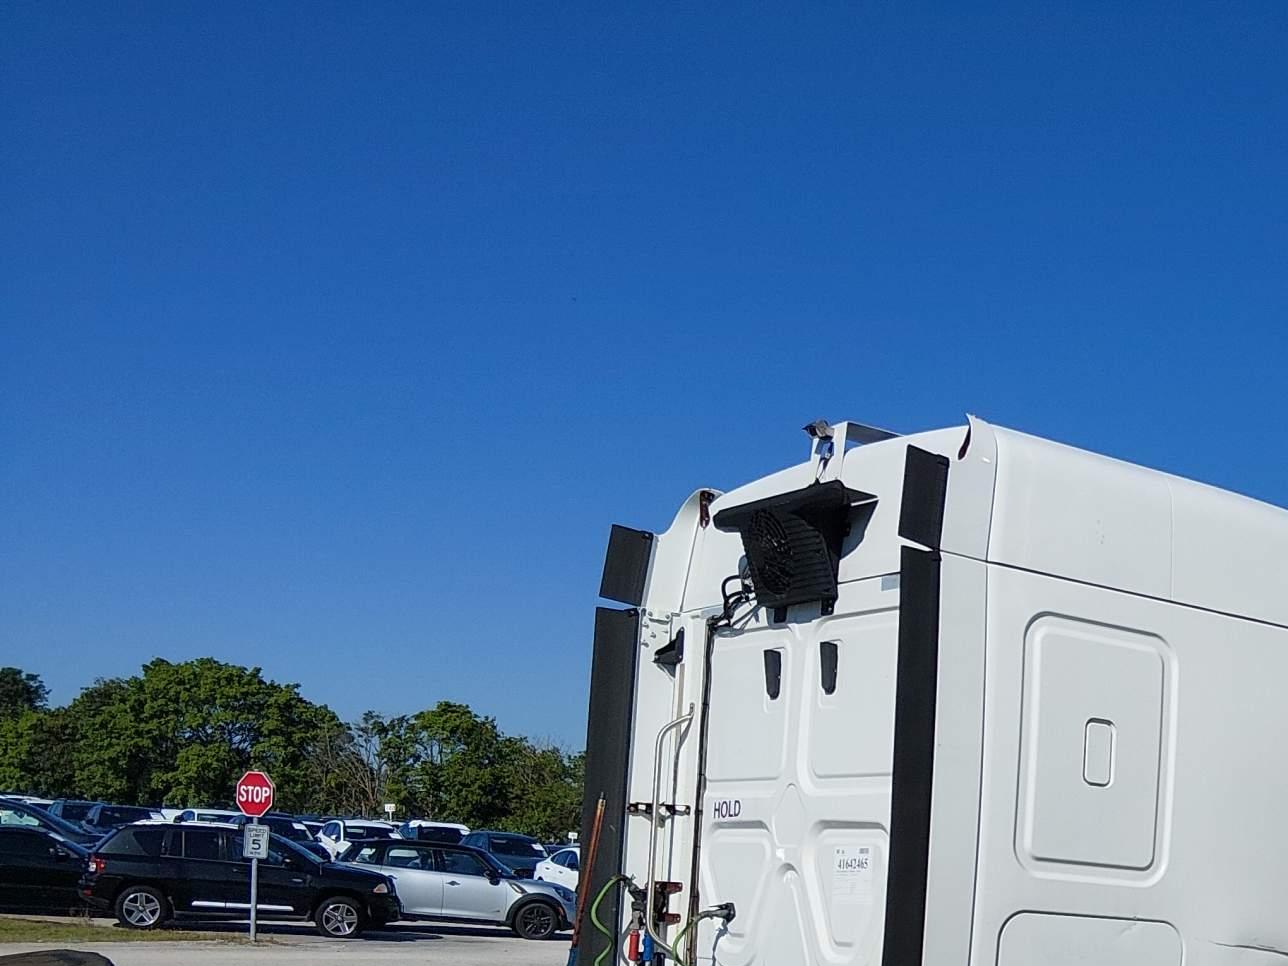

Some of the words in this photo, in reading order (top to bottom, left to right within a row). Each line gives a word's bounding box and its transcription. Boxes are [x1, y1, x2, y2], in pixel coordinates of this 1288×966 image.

[239, 785, 270, 803] STOP
[714, 800, 741, 818] HOLD
[251, 839, 262, 850] 5
[837, 857, 869, 870] 41642465
